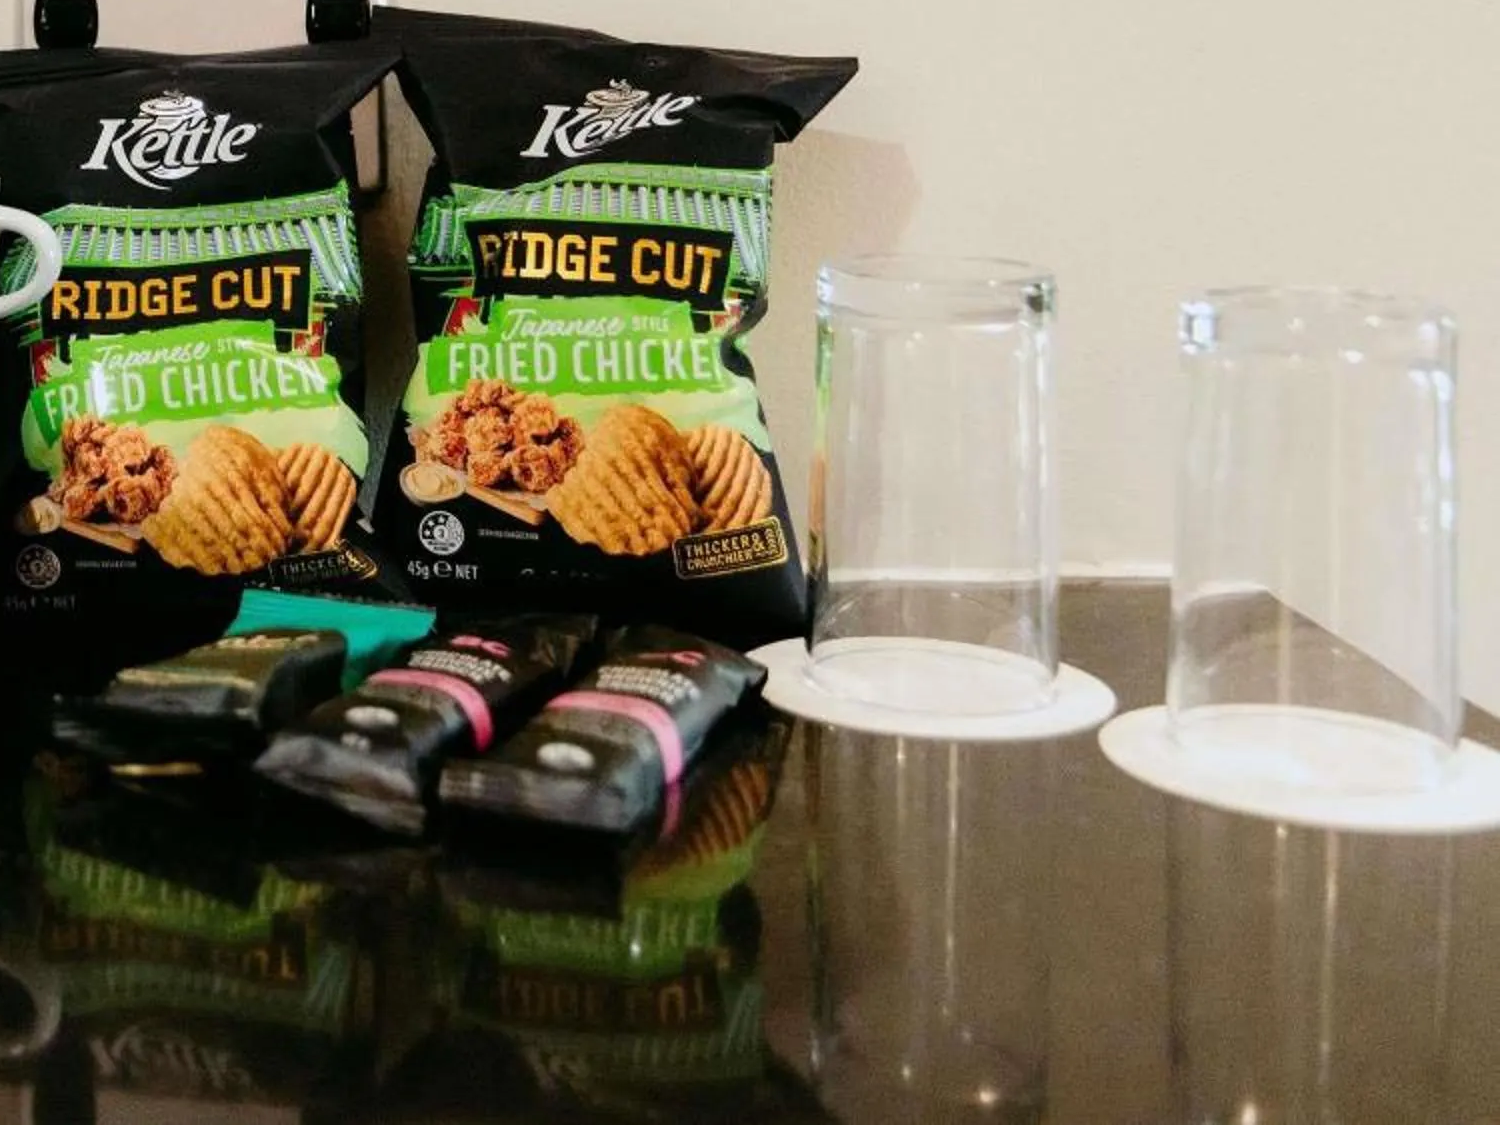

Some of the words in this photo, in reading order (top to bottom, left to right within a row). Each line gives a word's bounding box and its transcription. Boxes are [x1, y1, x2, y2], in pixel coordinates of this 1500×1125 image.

[520, 91, 699, 159] Kettle
[80, 111, 258, 191] Kettle
[478, 231, 619, 283] RIDGE
[631, 237, 723, 295] CUT
[51, 278, 199, 321] RIDGE
[211, 265, 301, 311] CUT
[500, 308, 624, 342] Japanese
[91, 339, 211, 373] Japanese
[447, 338, 558, 384] FRIED
[160, 355, 328, 409] CHICKEN
[407, 559, 430, 581] 45g
[455, 563, 479, 581] NET
[683, 534, 749, 558] THICKER
